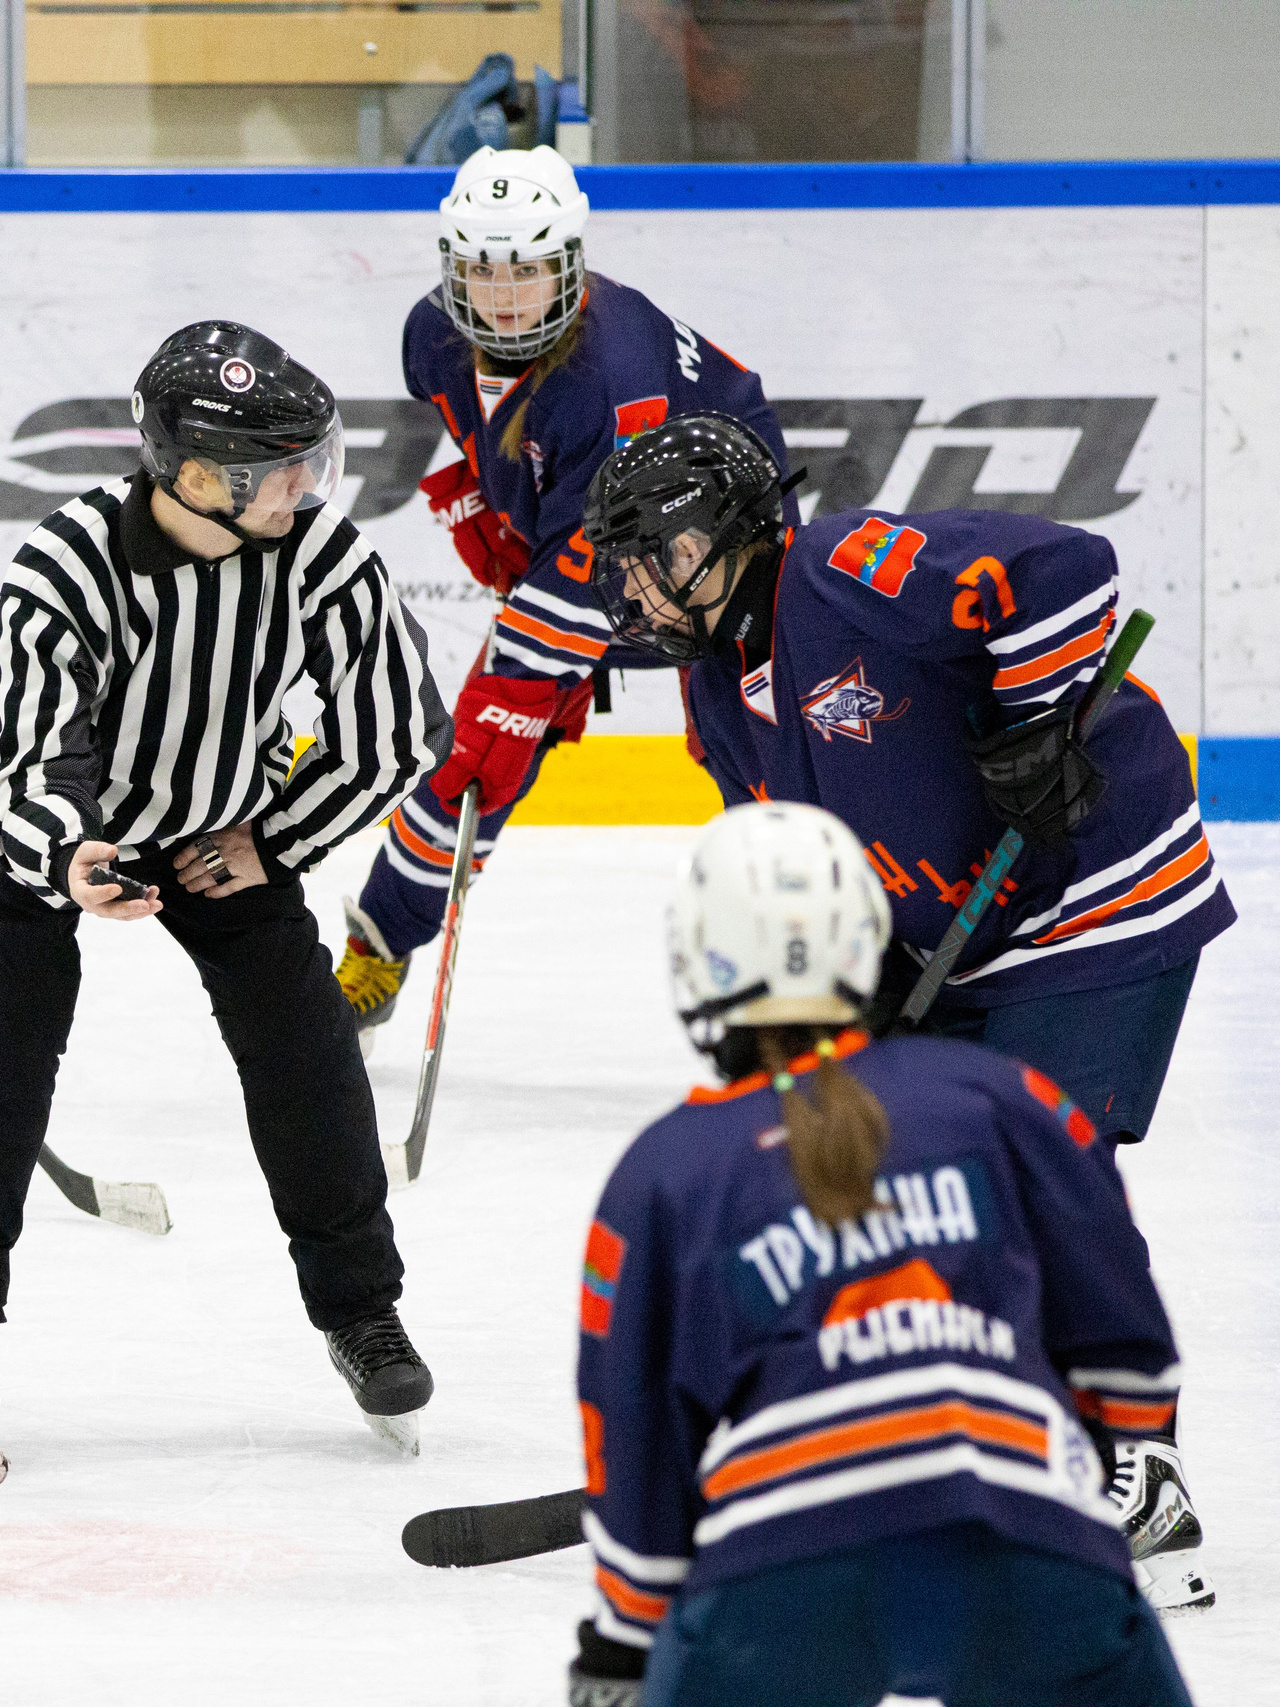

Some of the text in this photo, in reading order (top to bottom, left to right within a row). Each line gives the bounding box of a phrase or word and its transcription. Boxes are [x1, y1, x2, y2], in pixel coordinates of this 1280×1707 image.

[492, 179, 509, 200] 9
[661, 487, 703, 514] CCM
[786, 937, 808, 976] 8
